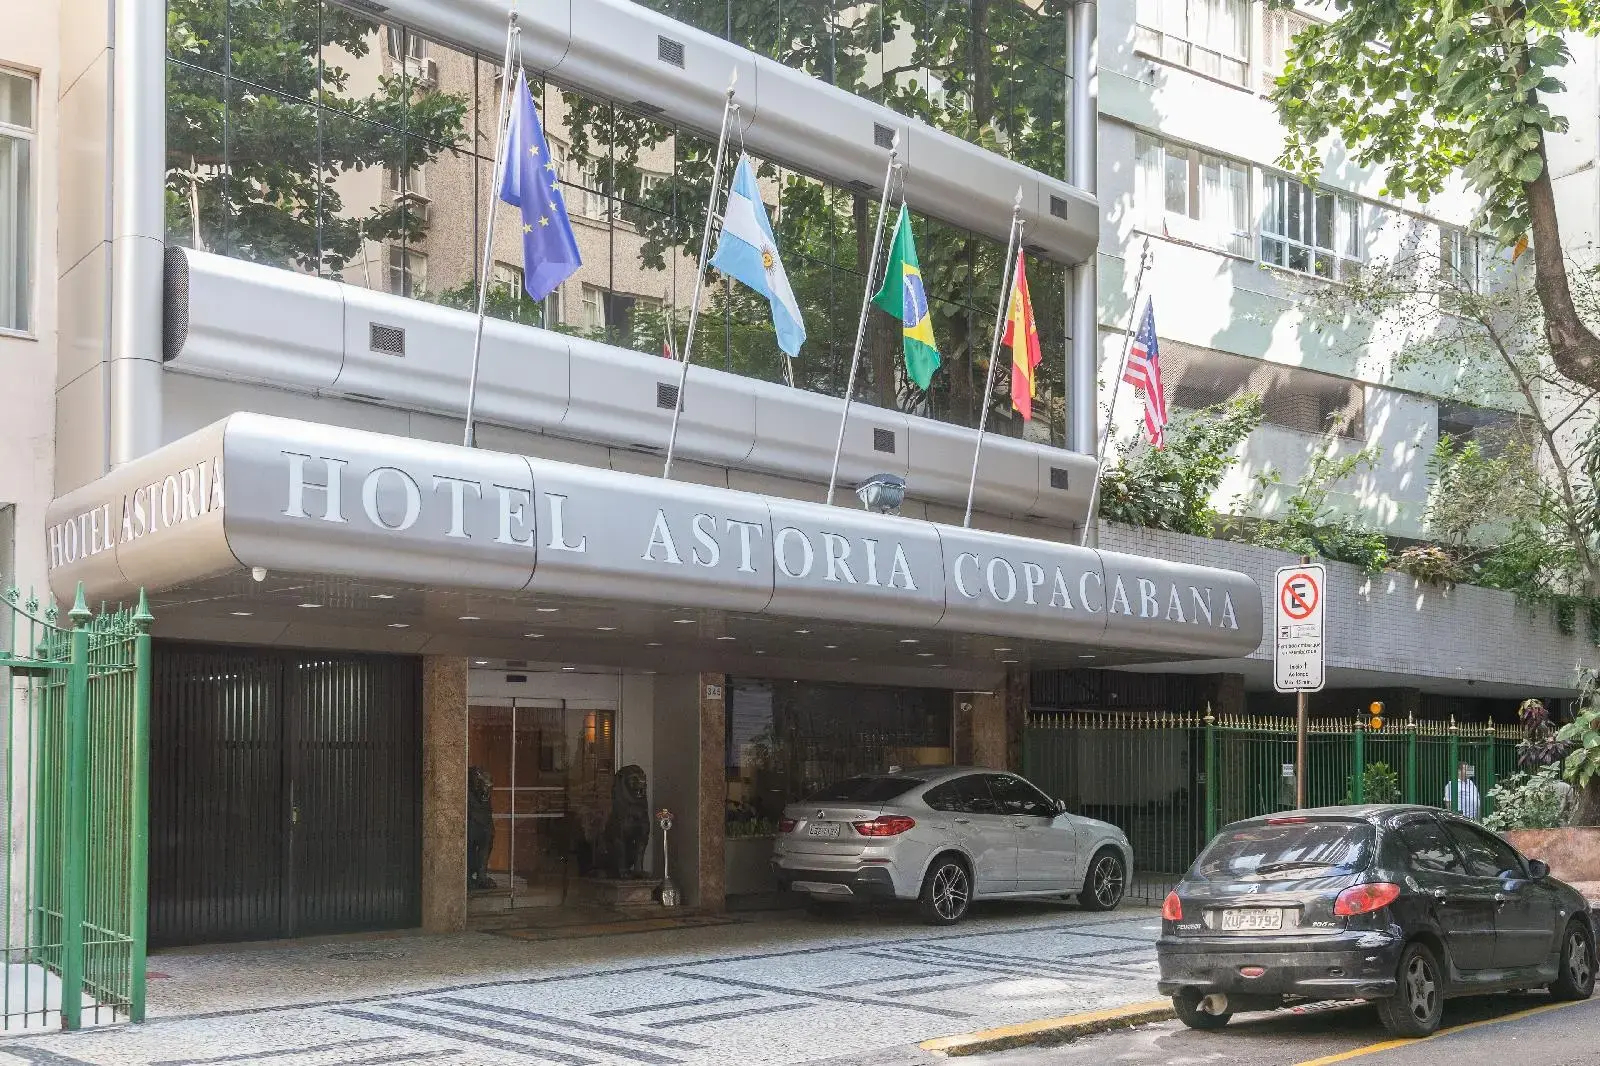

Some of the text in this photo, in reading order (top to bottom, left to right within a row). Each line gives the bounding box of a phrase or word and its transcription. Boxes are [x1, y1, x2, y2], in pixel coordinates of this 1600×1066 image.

[49, 456, 224, 570] HOTEL ASTORIA
[281, 450, 1240, 631] HOTEL ASTORIA COPACABANA
